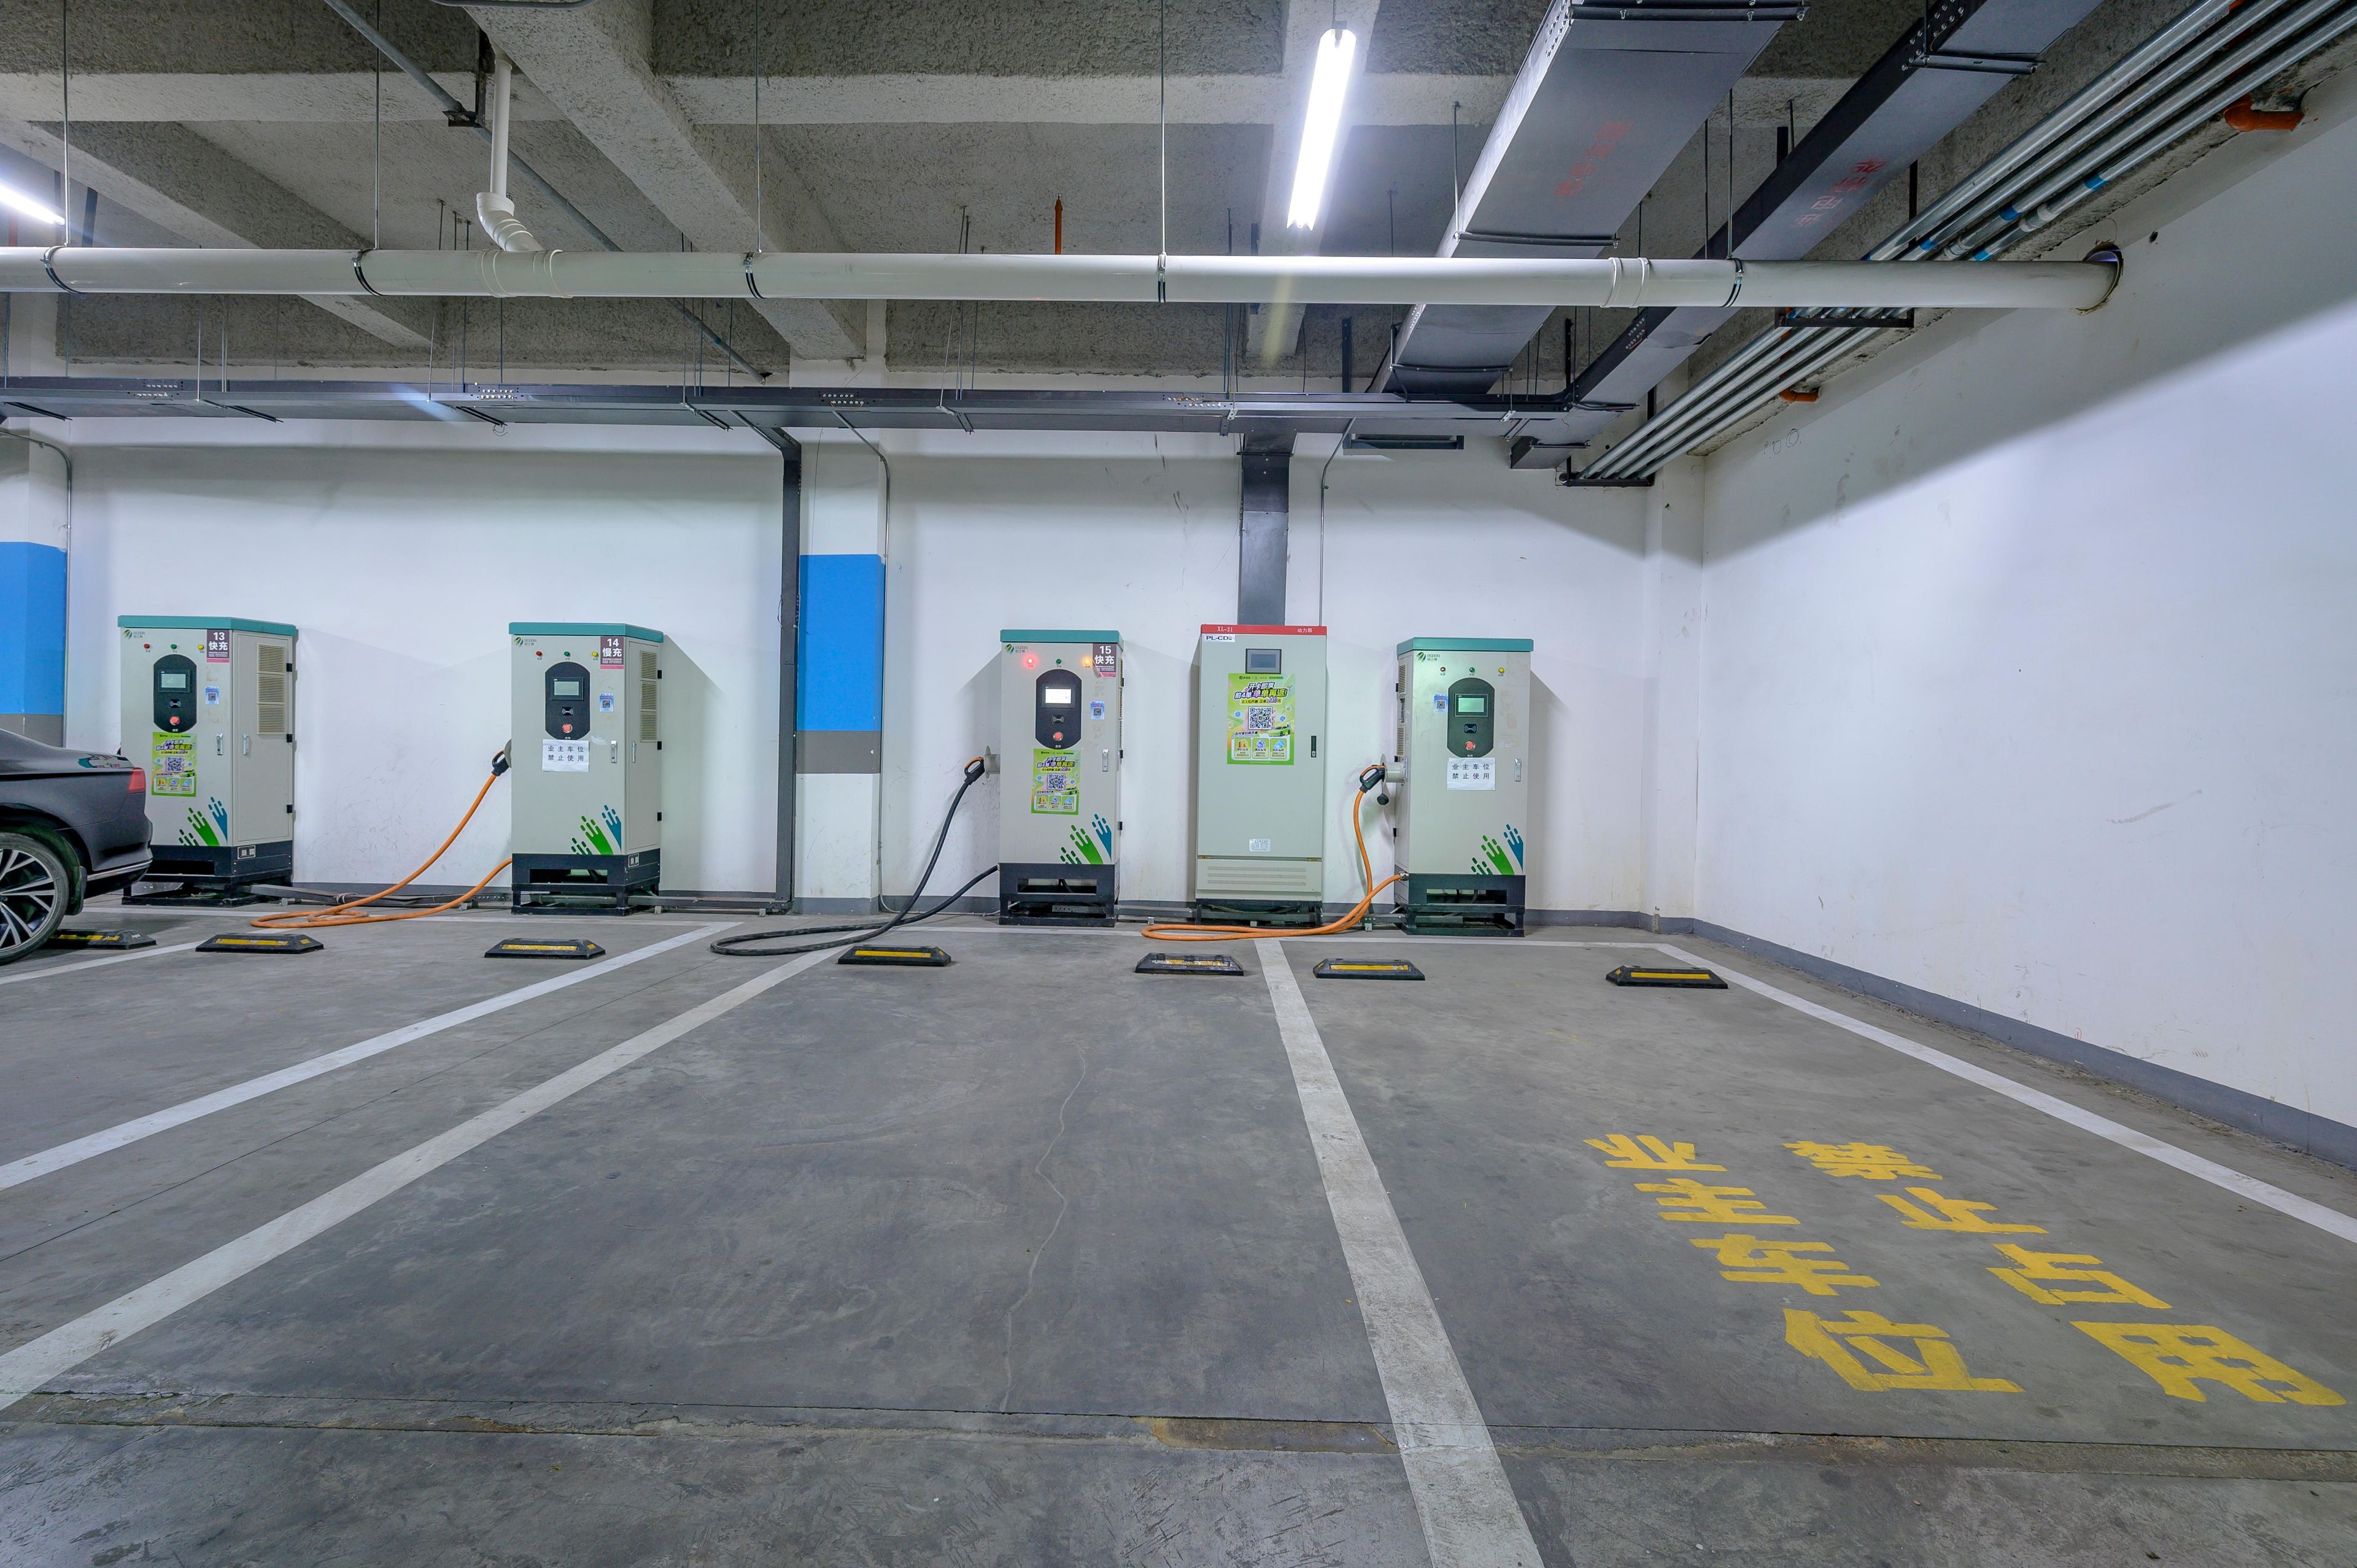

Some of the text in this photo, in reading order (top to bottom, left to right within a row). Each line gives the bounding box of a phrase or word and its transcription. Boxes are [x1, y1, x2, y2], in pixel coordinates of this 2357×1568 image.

[213, 631, 225, 641] 13
[209, 641, 228, 651] 快充
[607, 638, 619, 647] 14
[602, 647, 622, 657] 慢充
[1099, 646, 1112, 654] 15
[1094, 655, 1115, 665] 快充
[1582, 1134, 2025, 1393] 业主车位
[1782, 1141, 2347, 1407] 禁止占用
